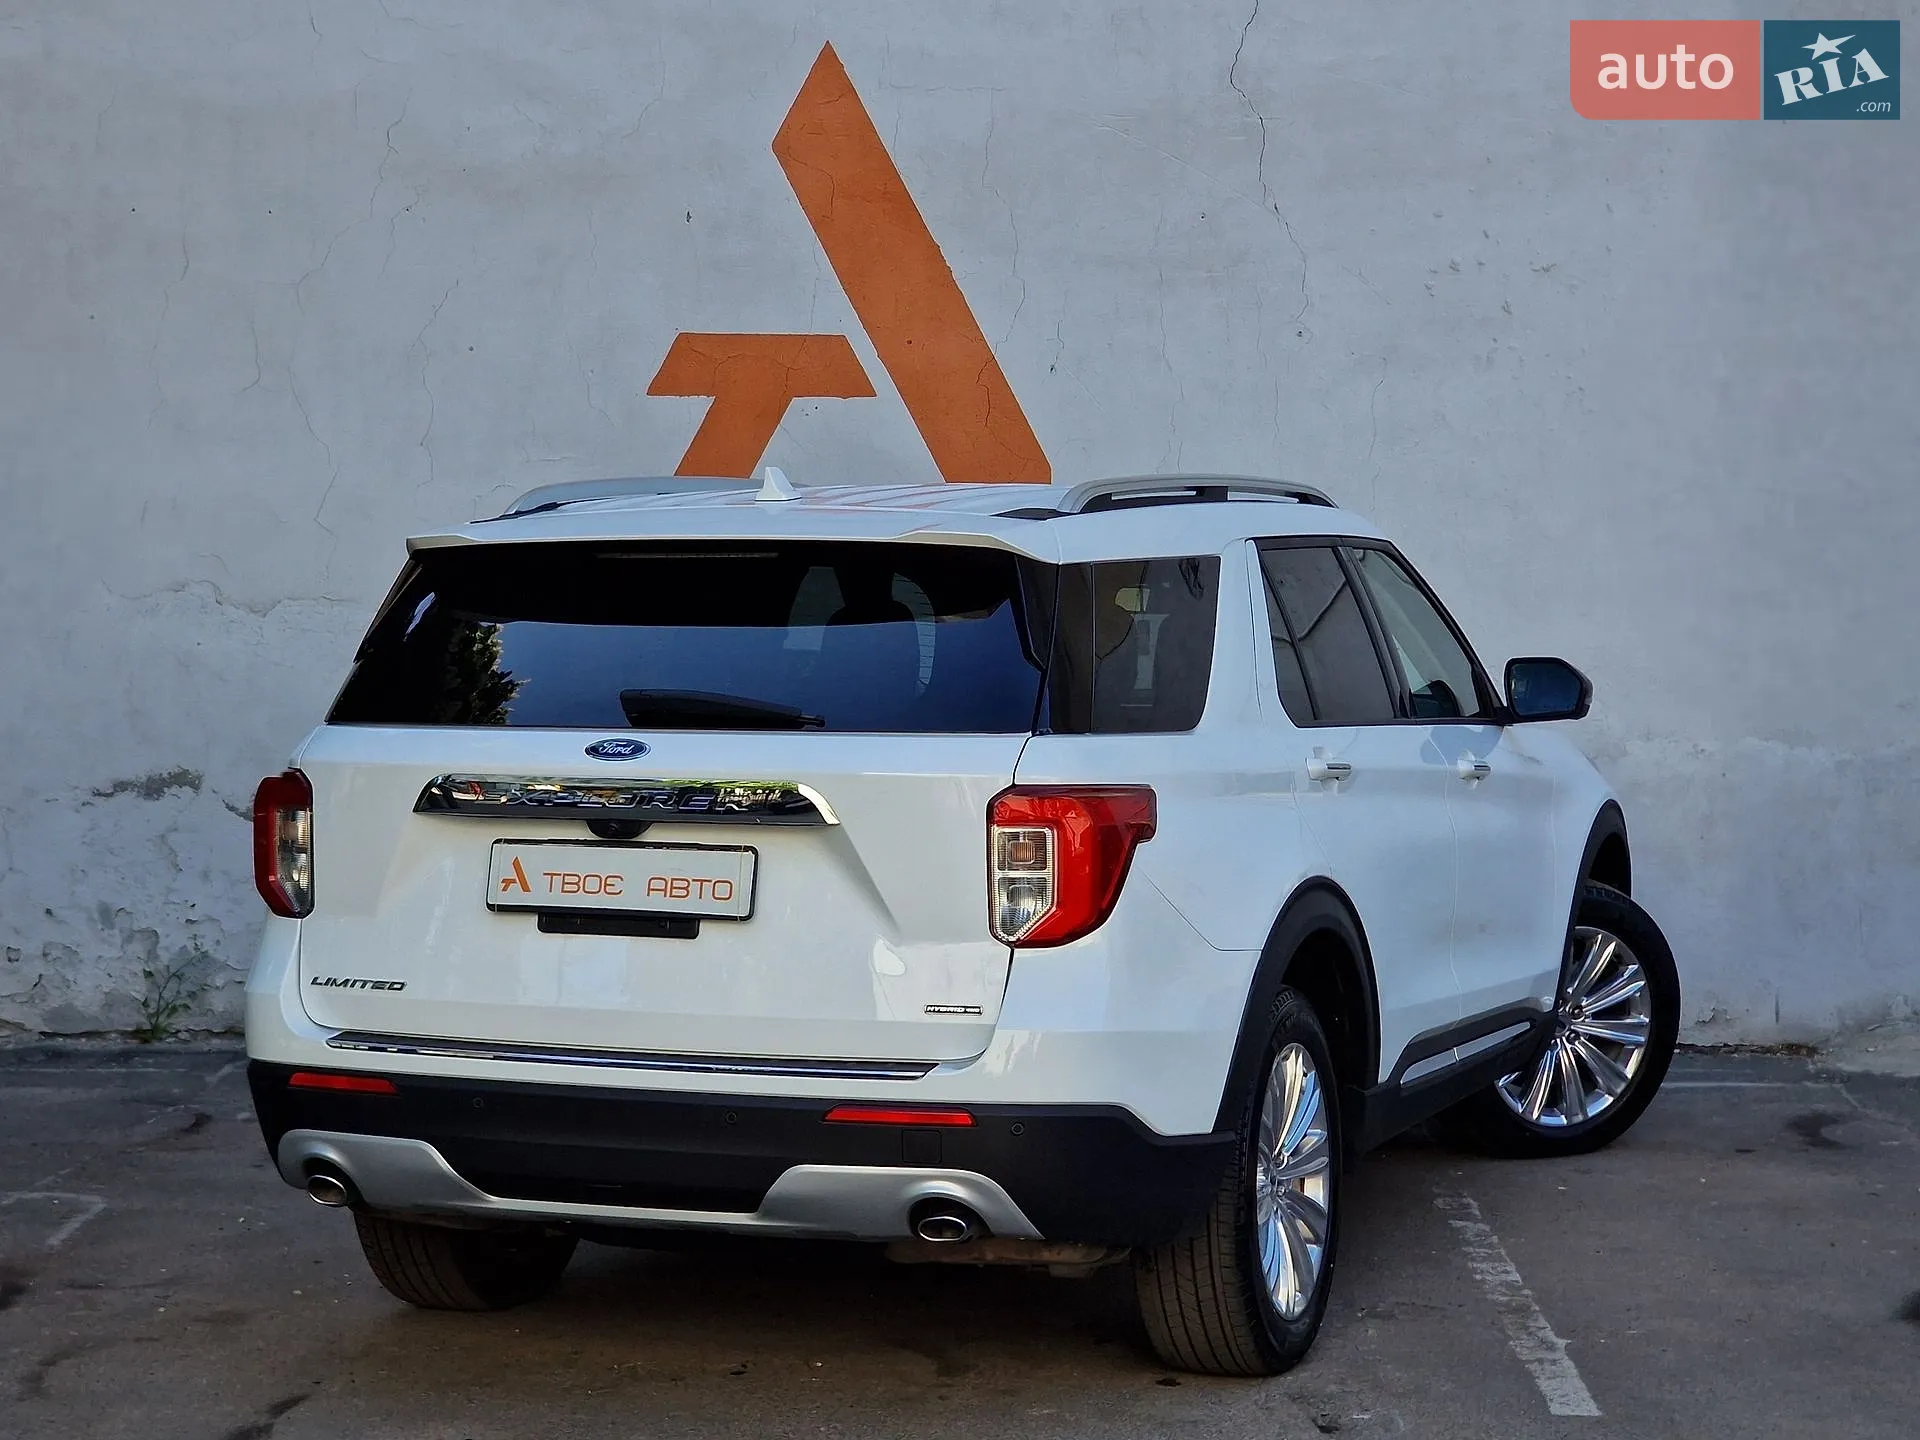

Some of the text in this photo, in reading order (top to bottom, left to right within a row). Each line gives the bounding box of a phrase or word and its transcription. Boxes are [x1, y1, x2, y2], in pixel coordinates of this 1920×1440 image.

[599, 741, 635, 754] Ford
[543, 872, 734, 901] ТВОЄ АВТО
[310, 976, 407, 991] LIMITED
